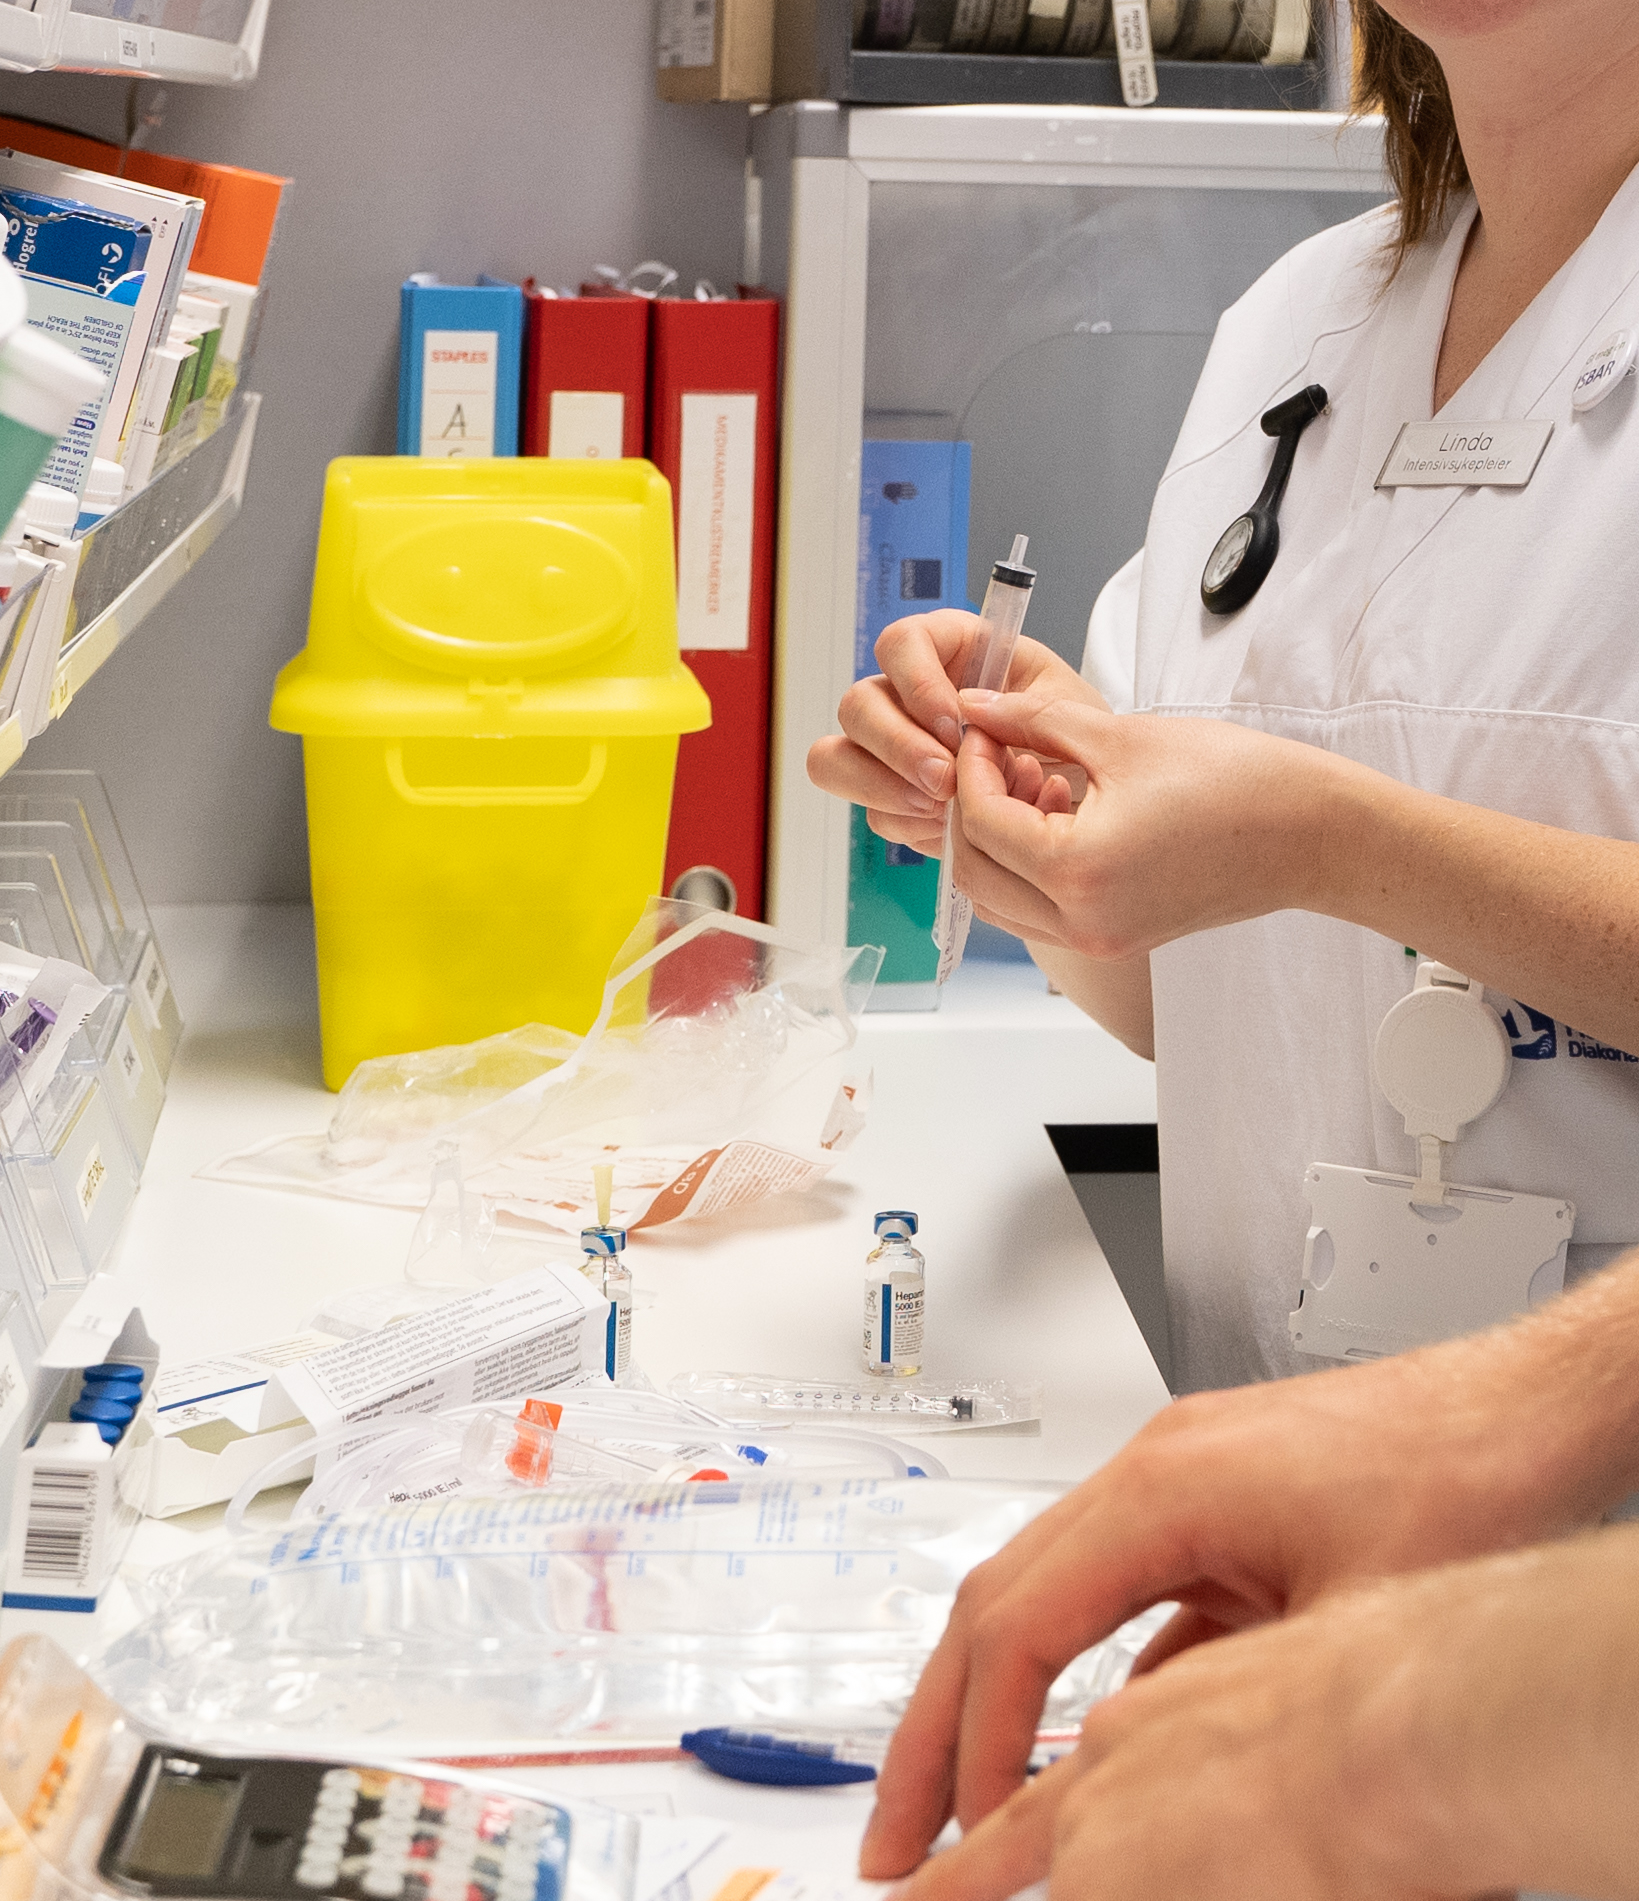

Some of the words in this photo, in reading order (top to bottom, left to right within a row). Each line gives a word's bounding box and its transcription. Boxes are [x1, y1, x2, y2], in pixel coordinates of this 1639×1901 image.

[48, 314, 68, 327] REACH
[69, 320, 80, 331] THE
[84, 315, 114, 329] CHILDREN
[83, 332, 102, 344] below
[93, 327, 105, 337] OUT
[105, 328, 121, 339] KEEP
[103, 338, 119, 348] Store
[430, 350, 489, 364] STAPLES
[1572, 359, 1616, 393] ISBAR
[441, 402, 467, 440] A
[1439, 431, 1494, 453] Linda
[1402, 456, 1512, 474] Intensivsykepleier
[894, 1302, 914, 1311] 5000
